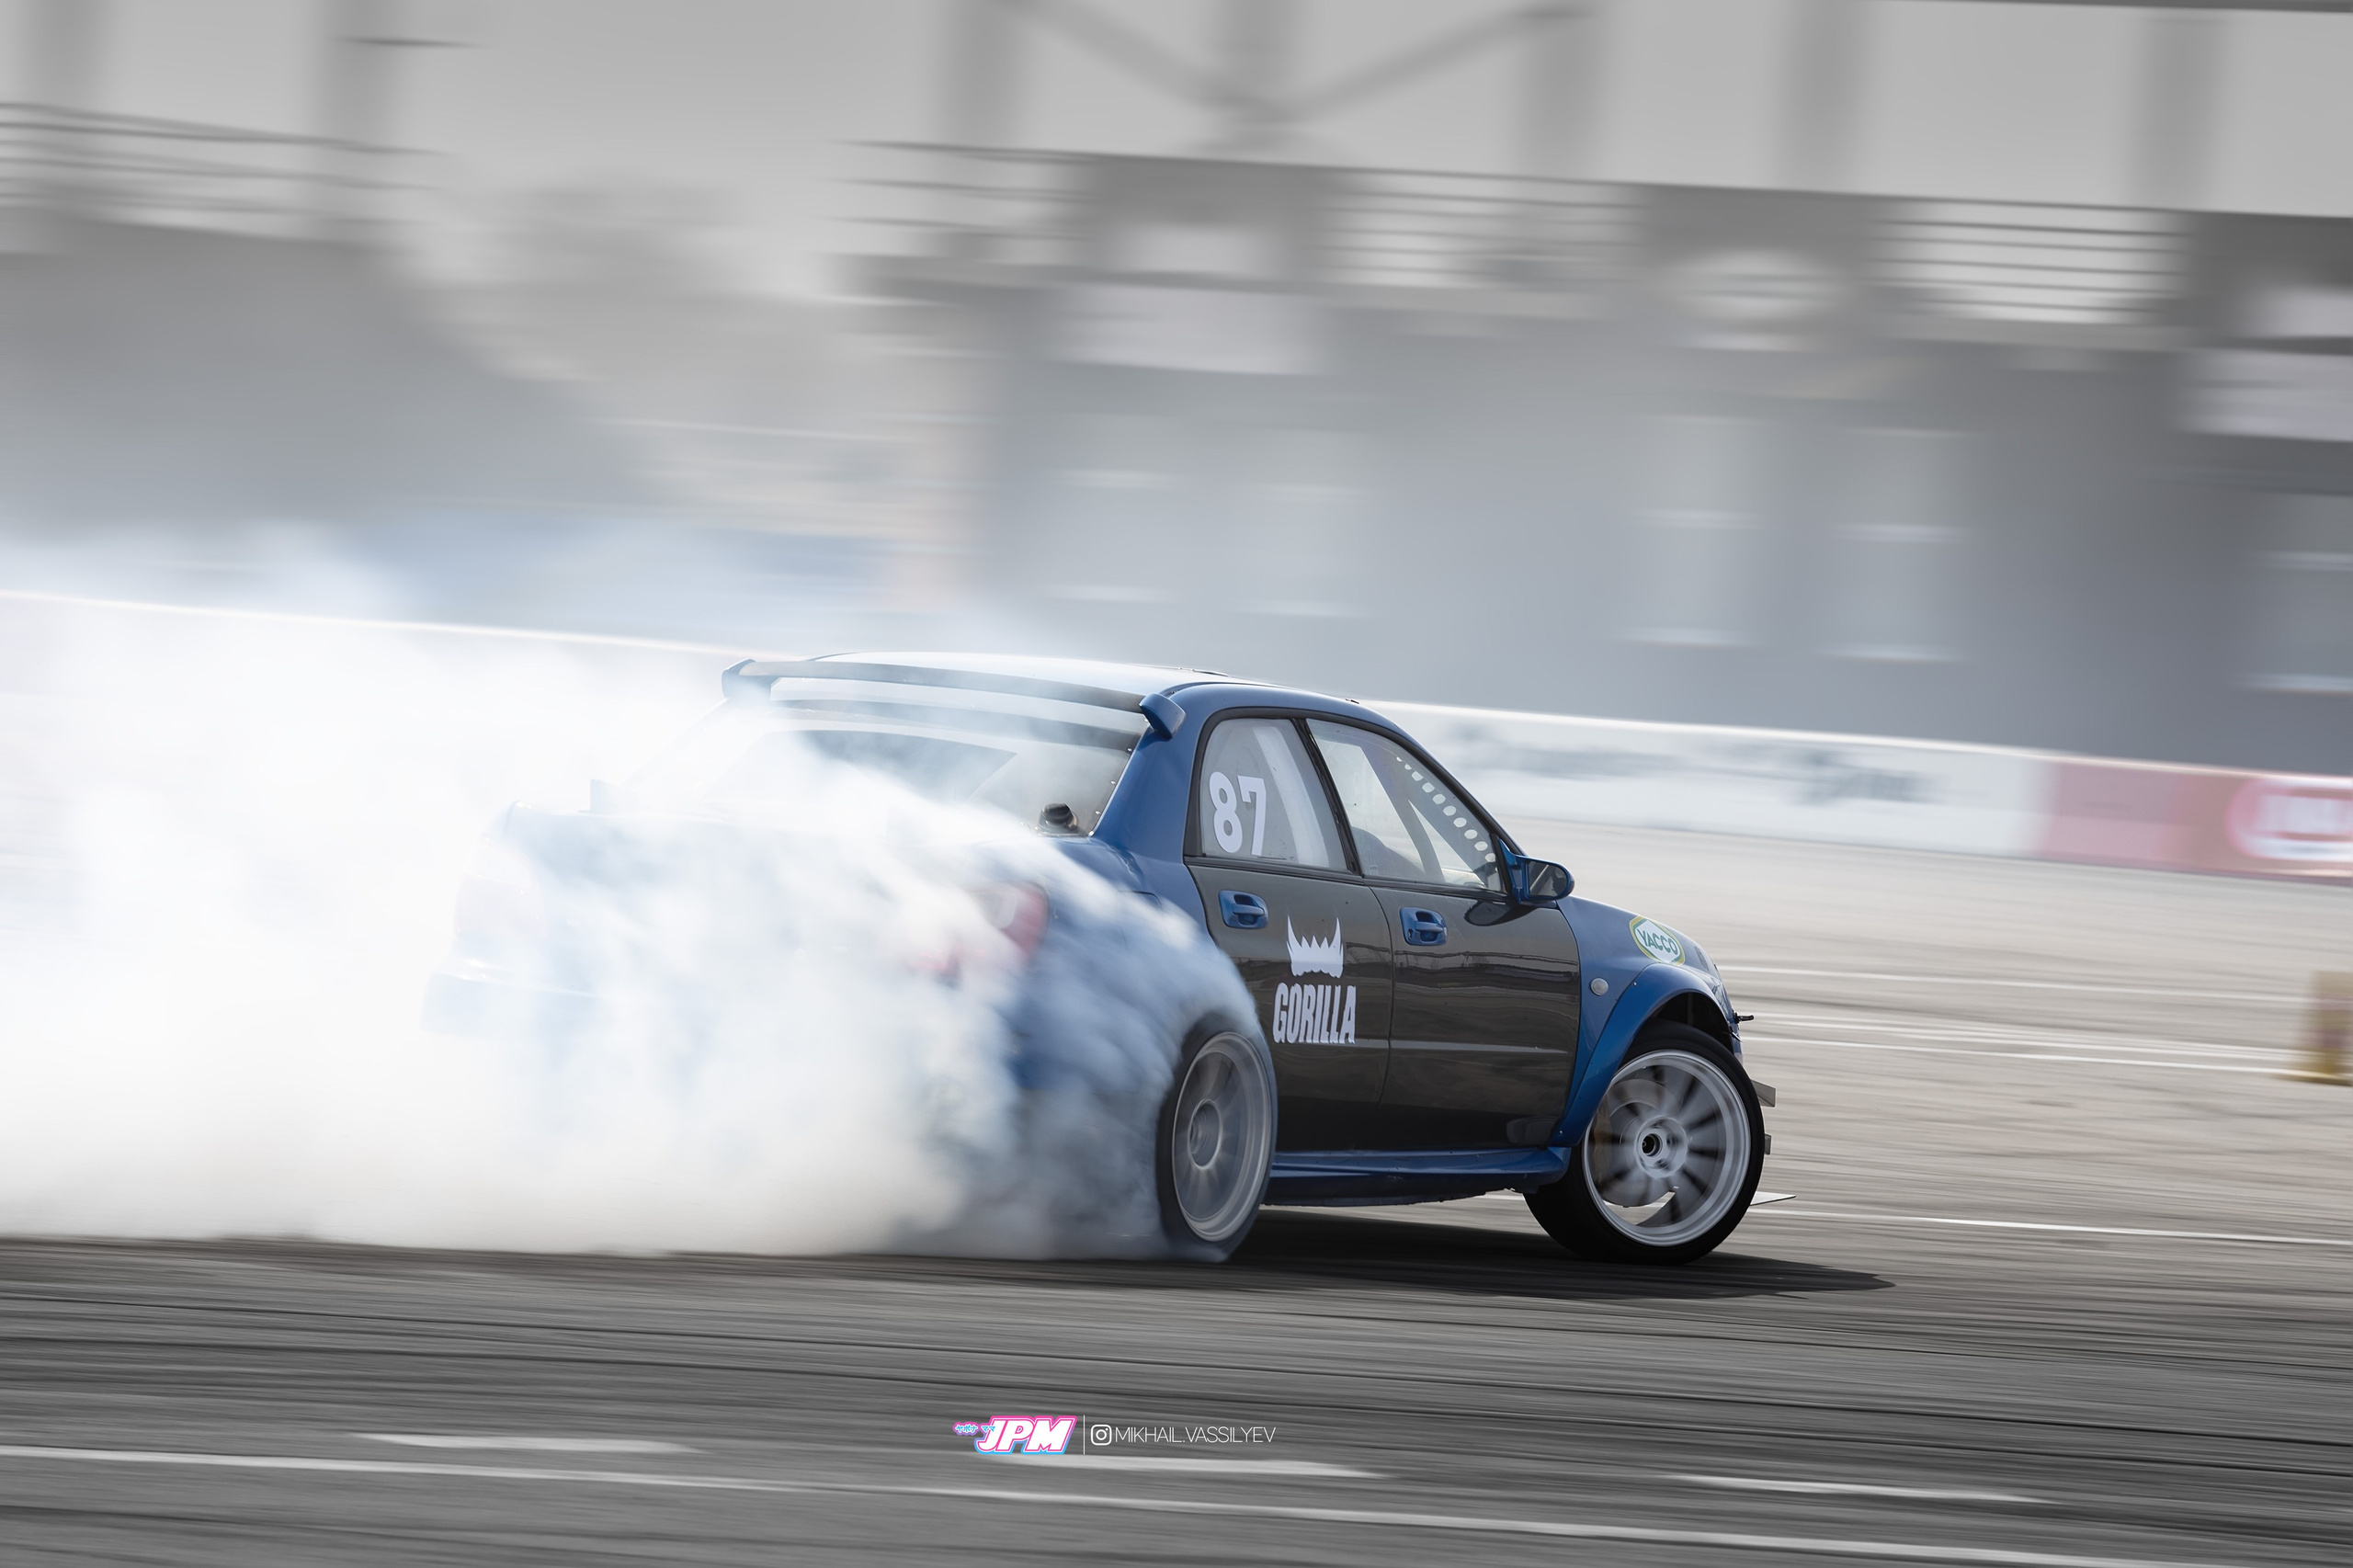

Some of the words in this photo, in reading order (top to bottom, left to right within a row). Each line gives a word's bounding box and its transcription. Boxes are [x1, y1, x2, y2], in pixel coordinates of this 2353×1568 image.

[1209, 771, 1267, 856] 87
[1637, 928, 1678, 956] YACCO
[1273, 983, 1357, 1044] GORILLA
